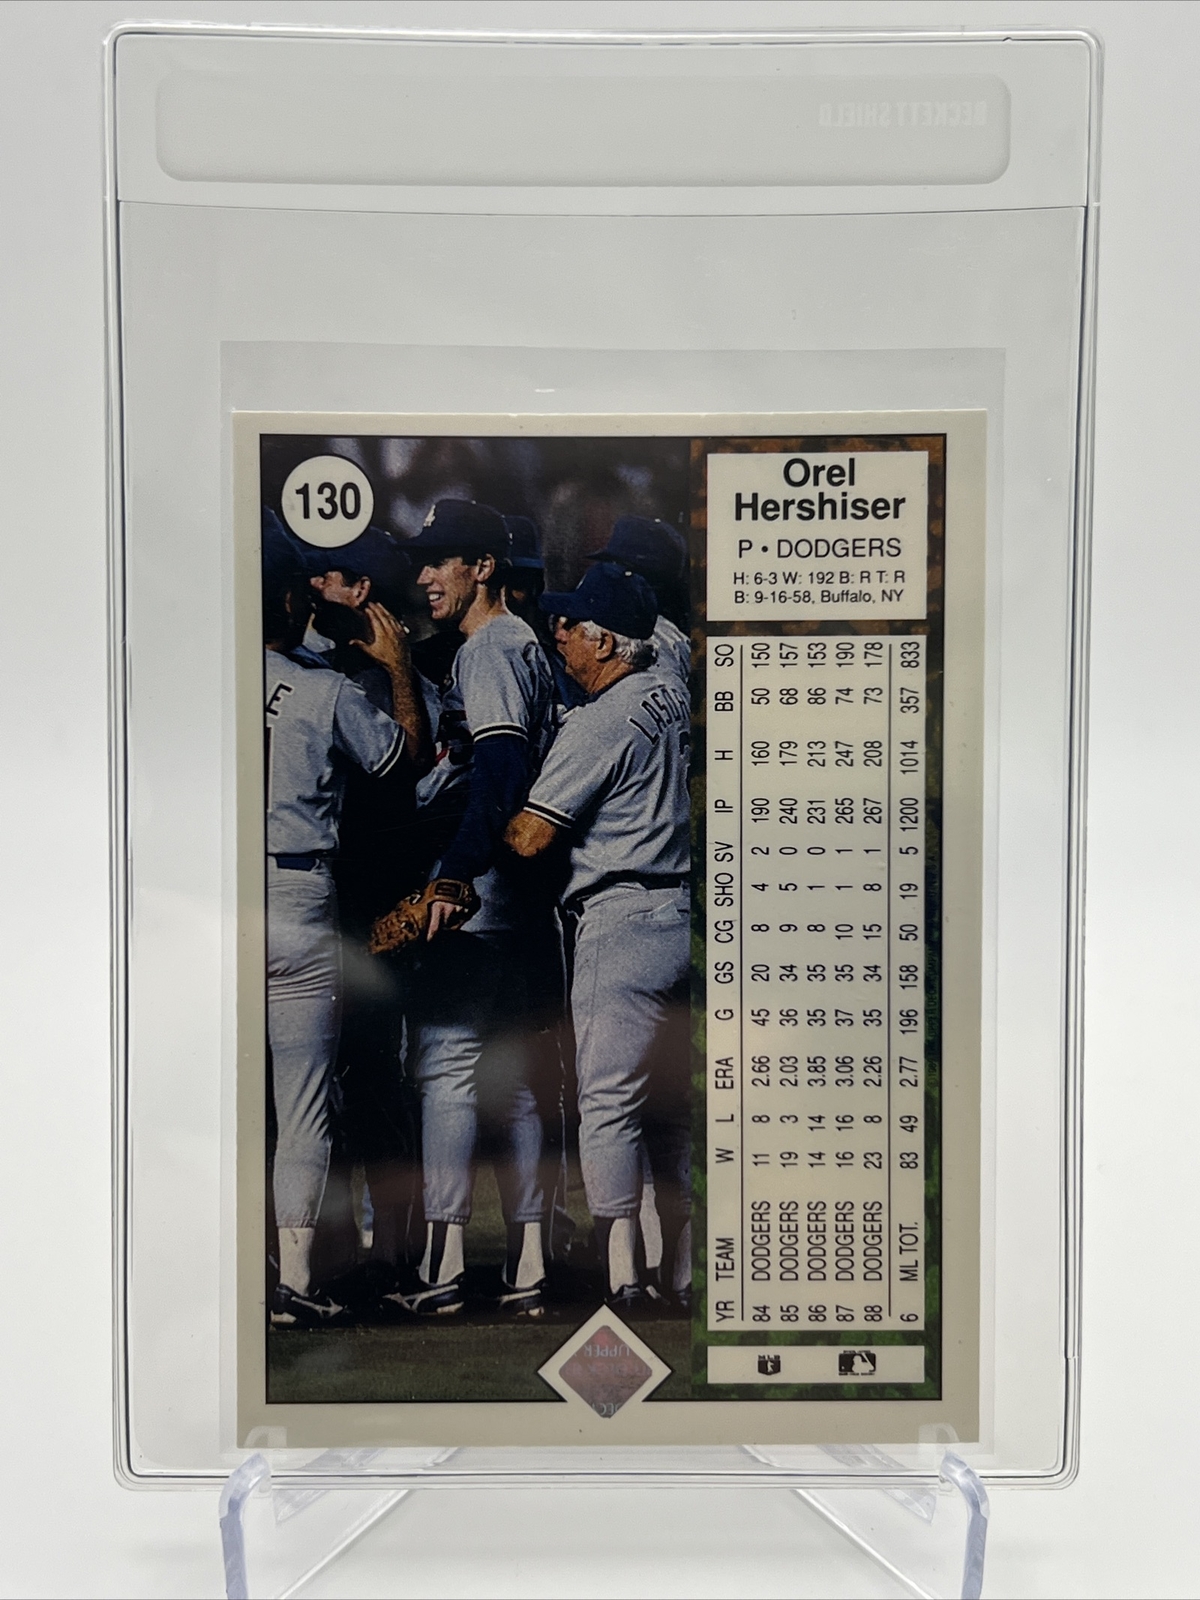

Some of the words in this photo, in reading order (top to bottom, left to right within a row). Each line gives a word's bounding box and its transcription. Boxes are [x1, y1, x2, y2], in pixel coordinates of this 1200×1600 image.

[783, 457, 856, 488] Orel
[294, 481, 362, 520] 130
[734, 491, 907, 522] Hershiser
[738, 539, 753, 559] P
[777, 537, 902, 559] DODGERS
[733, 571, 750, 585] H:
[753, 571, 778, 586] 6-3
[782, 571, 802, 585] W:
[808, 571, 835, 585] 192
[839, 570, 855, 585] B:
[859, 570, 871, 584] R
[876, 570, 889, 584] T:
[893, 569, 906, 584] R
[734, 590, 750, 604] B:
[754, 590, 816, 606] 9-16-58,
[820, 589, 877, 605] Buffalo,
[881, 588, 904, 603] NY
[714, 643, 735, 668] SO
[750, 642, 771, 669] 150
[779, 642, 799, 669] 157
[807, 642, 827, 668] 153
[835, 642, 855, 668] 190
[863, 641, 884, 668] 178
[900, 641, 920, 669] 833
[714, 690, 734, 712] BB
[750, 687, 771, 706] 50
[779, 687, 799, 706] 68
[807, 687, 827, 706] 86
[834, 687, 854, 705] 74
[863, 687, 883, 705] 73
[899, 686, 920, 714] 357
[714, 749, 734, 761] H
[750, 740, 770, 767] 160
[778, 740, 799, 766] 179
[806, 740, 827, 768] 213
[834, 740, 854, 768] 247
[863, 740, 883, 767] 208
[899, 740, 919, 775] 1014
[714, 798, 734, 813] IP
[750, 797, 770, 824] 190
[778, 797, 798, 825] 240
[806, 800, 826, 825] 231
[834, 797, 855, 825] 265
[862, 797, 883, 825] 267
[899, 797, 919, 832] 1200
[713, 840, 734, 863] SV
[750, 846, 770, 856] 2
[778, 846, 798, 856] 0
[806, 846, 826, 856] 0
[898, 846, 919, 856] 5
[713, 872, 734, 907] SHO
[750, 882, 770, 892] 4
[778, 882, 798, 892] 5
[862, 882, 883, 892] 8
[898, 882, 919, 900] 19
[713, 919, 735, 944] CG
[750, 923, 770, 933] 8
[778, 923, 799, 933] 9
[806, 923, 826, 933] 8
[834, 923, 854, 941] 10
[862, 923, 883, 941] 15
[898, 923, 919, 942] 50
[714, 961, 735, 985] GS
[750, 963, 770, 982] 20
[778, 963, 799, 982] 34
[806, 963, 827, 983] 35
[834, 963, 854, 983] 35
[862, 964, 883, 983] 34
[898, 964, 919, 990] 158
[714, 1008, 734, 1021] G
[750, 1008, 771, 1027] 45
[778, 1008, 799, 1027] 36
[806, 1008, 827, 1027] 35
[834, 1008, 855, 1027] 37
[862, 1008, 883, 1028] 35
[898, 1008, 919, 1035] 196
[714, 1056, 735, 1090] ERA
[751, 1055, 771, 1087] 2.66
[779, 1055, 799, 1087] 2.03
[806, 1055, 827, 1087] 3.85
[834, 1055, 855, 1088] 3.06
[862, 1055, 883, 1088] 2.26
[898, 1055, 919, 1088] 2.77
[715, 1113, 735, 1123] L
[751, 1114, 771, 1124] 8
[779, 1114, 799, 1124] 3
[807, 1114, 826, 1132] 14
[834, 1114, 855, 1132] 16
[862, 1114, 883, 1124] 8
[898, 1114, 919, 1134] 49
[715, 1147, 735, 1164] W
[752, 1153, 770, 1167] 11
[779, 1151, 799, 1168] 19
[807, 1151, 826, 1168] 14
[835, 1151, 855, 1168] 16
[863, 1151, 883, 1170] 23
[899, 1151, 919, 1170] 83
[750, 1200, 772, 1282] DODGERS
[778, 1200, 800, 1282] DODGERS
[806, 1200, 827, 1282] DODGERS
[834, 1200, 855, 1282] DODGERS
[862, 1200, 883, 1282] DODGERS
[898, 1221, 919, 1256] TOT.
[715, 1237, 735, 1282] TEAM
[898, 1259, 919, 1282] ML
[715, 1300, 735, 1323] YR
[751, 1304, 772, 1323] 84
[779, 1304, 800, 1323] 85
[807, 1304, 827, 1323] 86
[835, 1304, 855, 1323] 87
[863, 1304, 883, 1323] 88
[899, 1313, 919, 1323] 6
[591, 1402, 622, 1416] DEC
